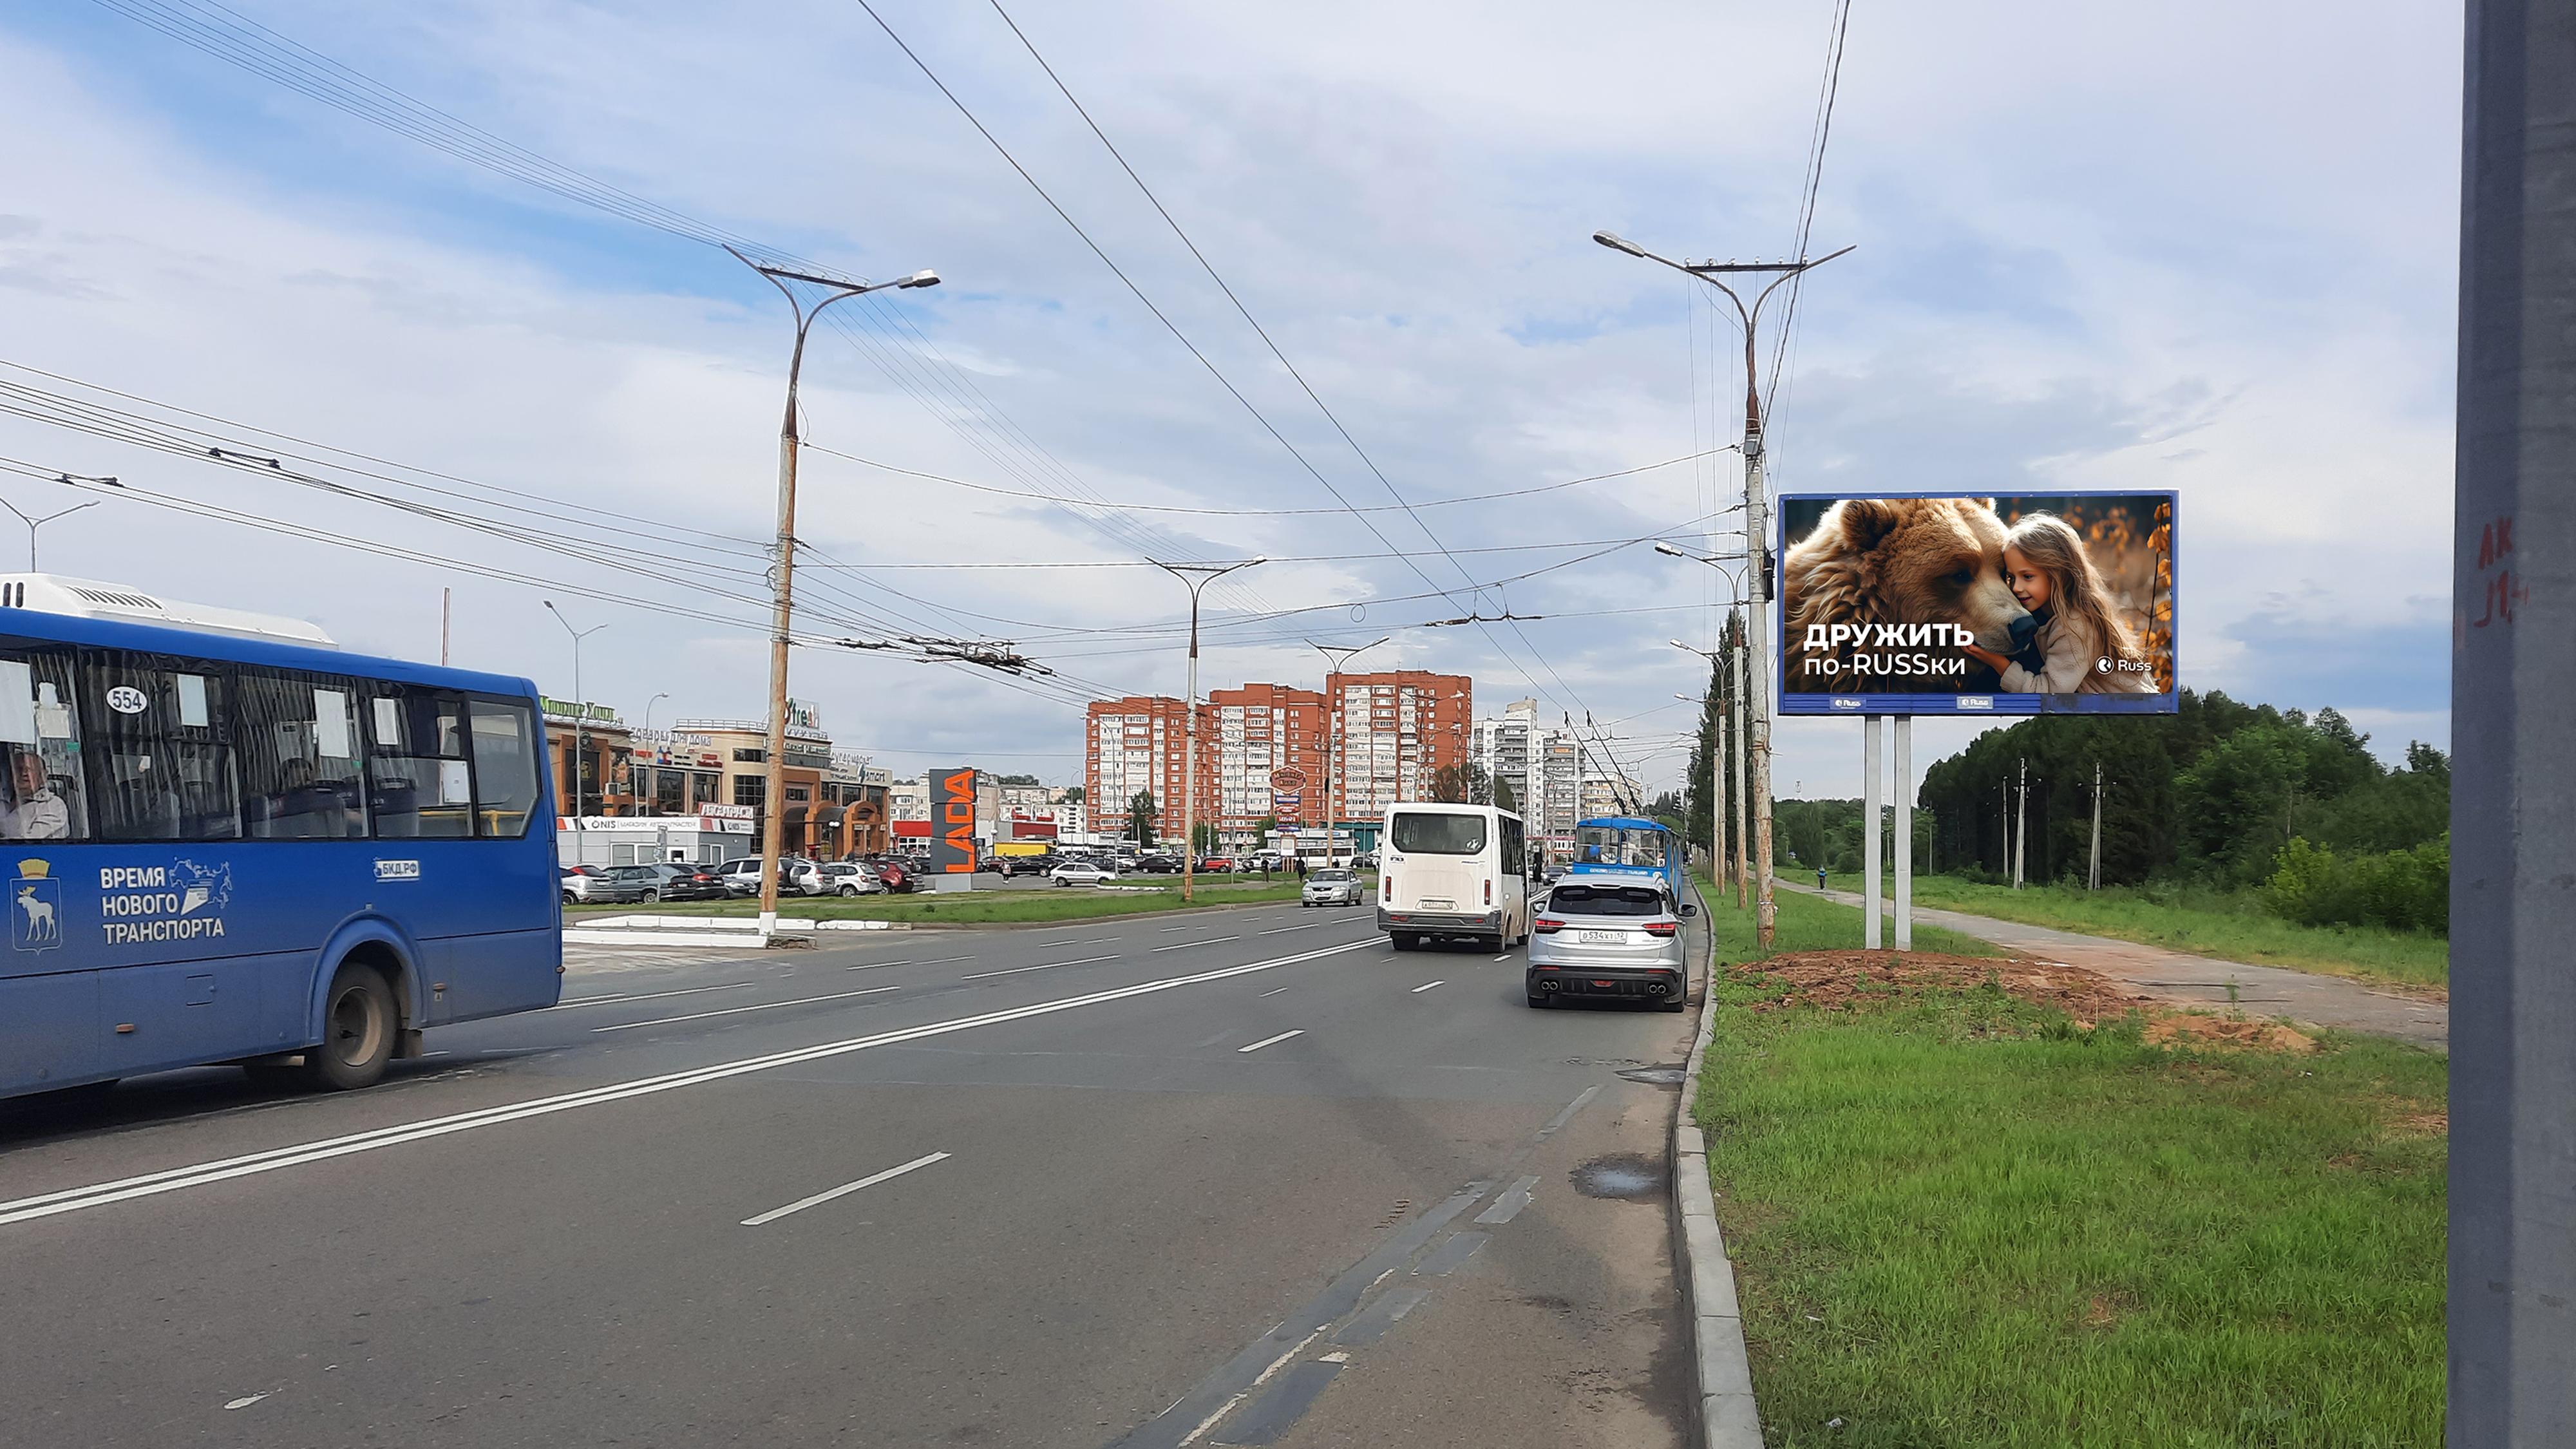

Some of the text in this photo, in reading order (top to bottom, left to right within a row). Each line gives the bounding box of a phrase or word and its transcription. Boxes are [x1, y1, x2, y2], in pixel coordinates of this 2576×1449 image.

[1803, 623, 1975, 651] ДРУЖИТЬ
[1804, 653, 1965, 675] по-RUSSки
[2117, 659, 2152, 671] Russ
[113, 690, 142, 710] 554
[944, 770, 974, 872] LADA
[100, 867, 165, 889] ВРЕМЯ
[383, 863, 417, 875] БКД.РФ
[102, 893, 178, 916] НОВОГО
[103, 918, 225, 945] ТРАНСПОРТА
